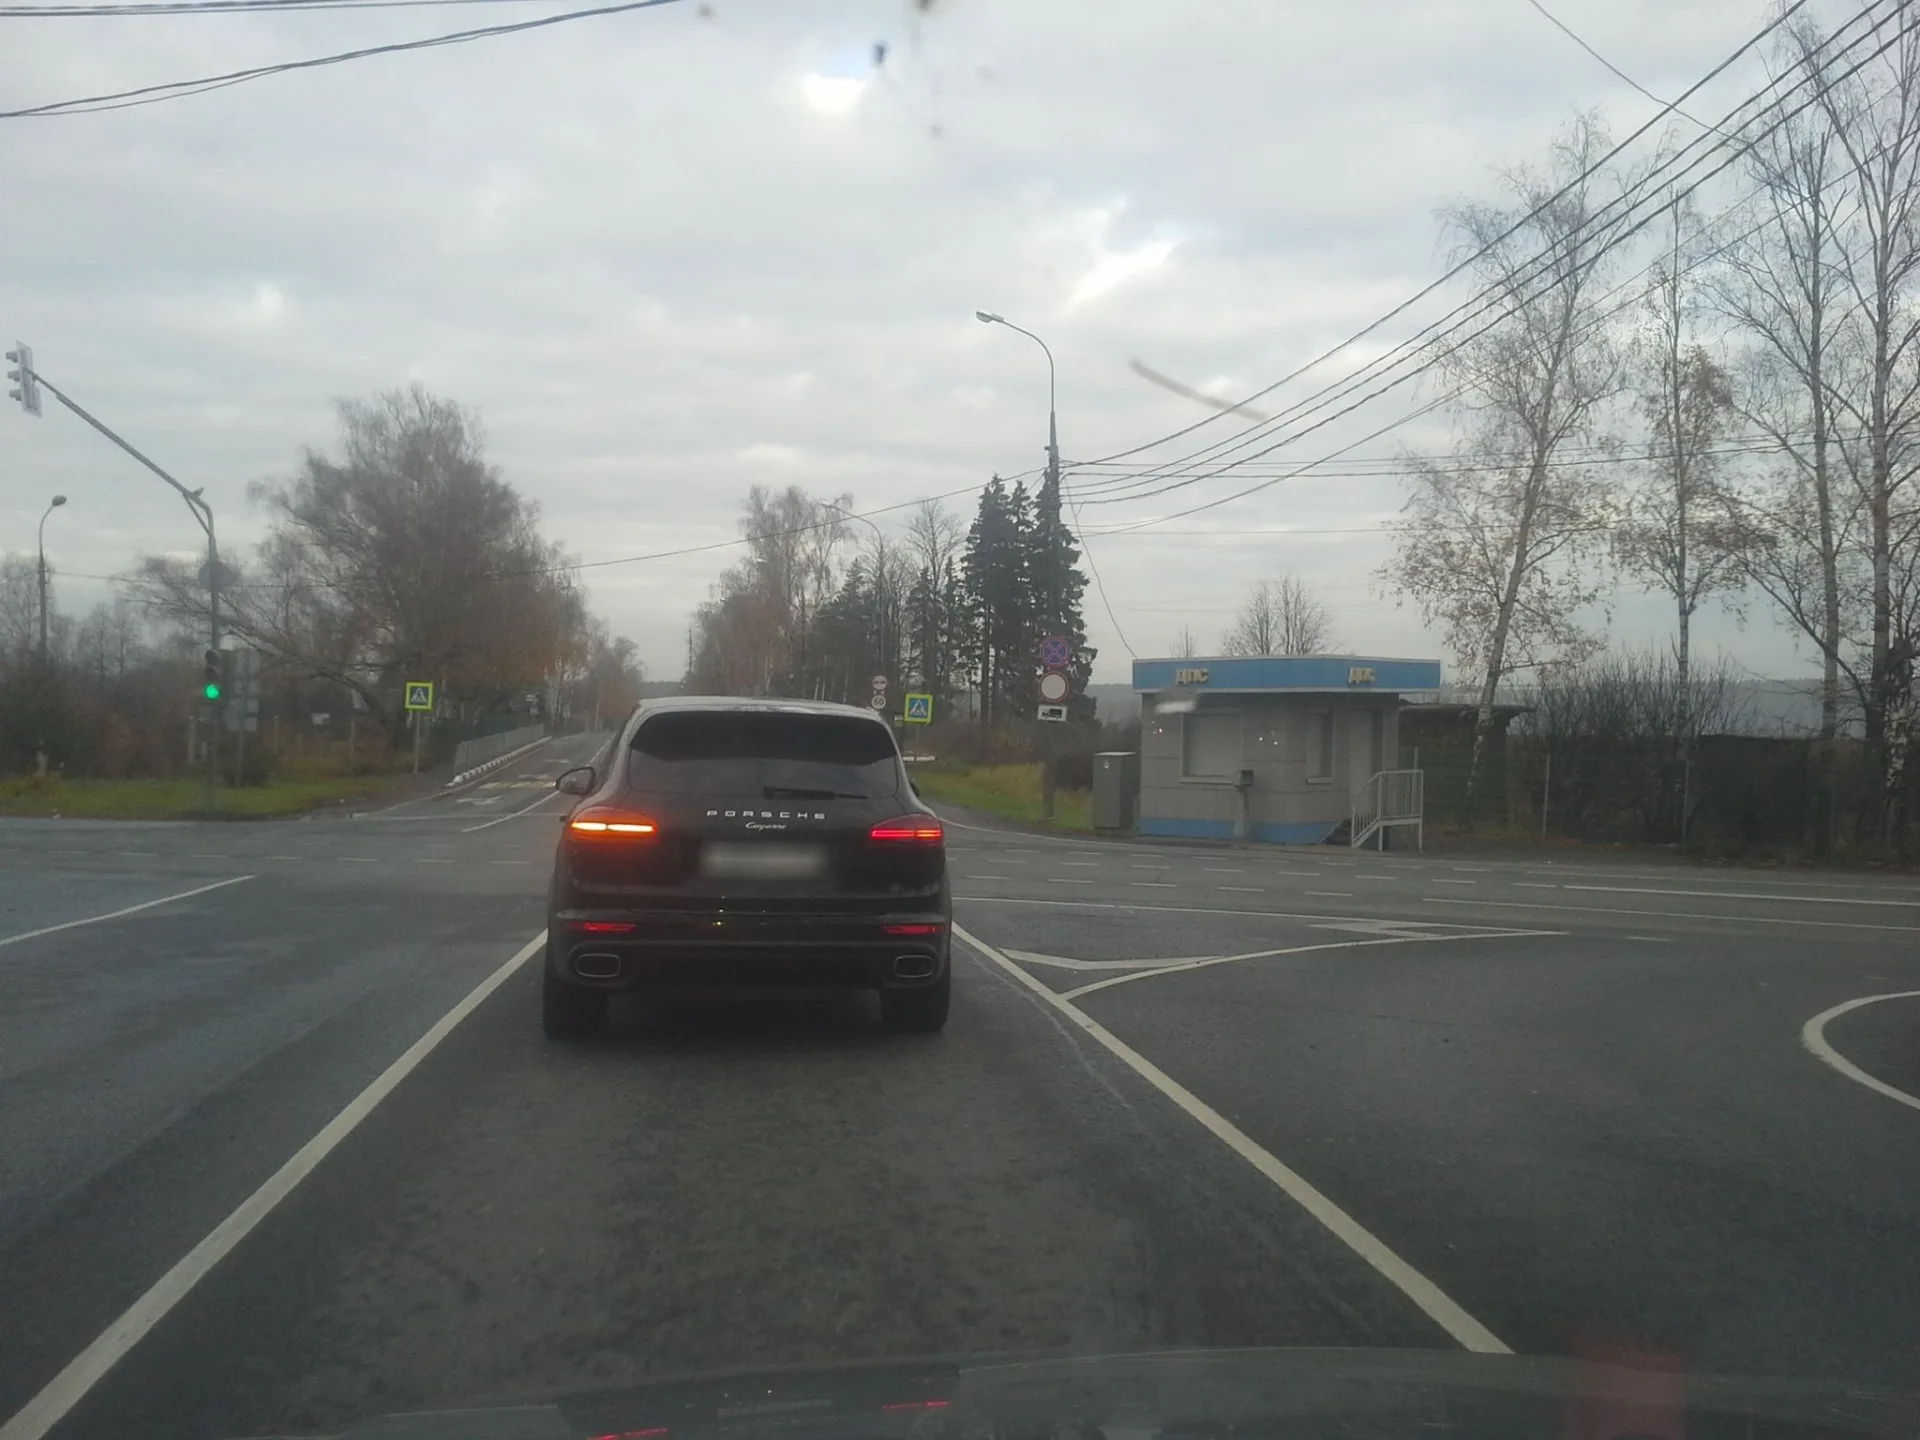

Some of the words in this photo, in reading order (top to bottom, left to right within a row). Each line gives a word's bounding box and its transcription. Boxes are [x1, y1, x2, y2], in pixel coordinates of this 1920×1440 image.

[1175, 667, 1209, 684] ДПС
[1348, 667, 1377, 684] ДПС
[706, 810, 825, 819] PORSCHE
